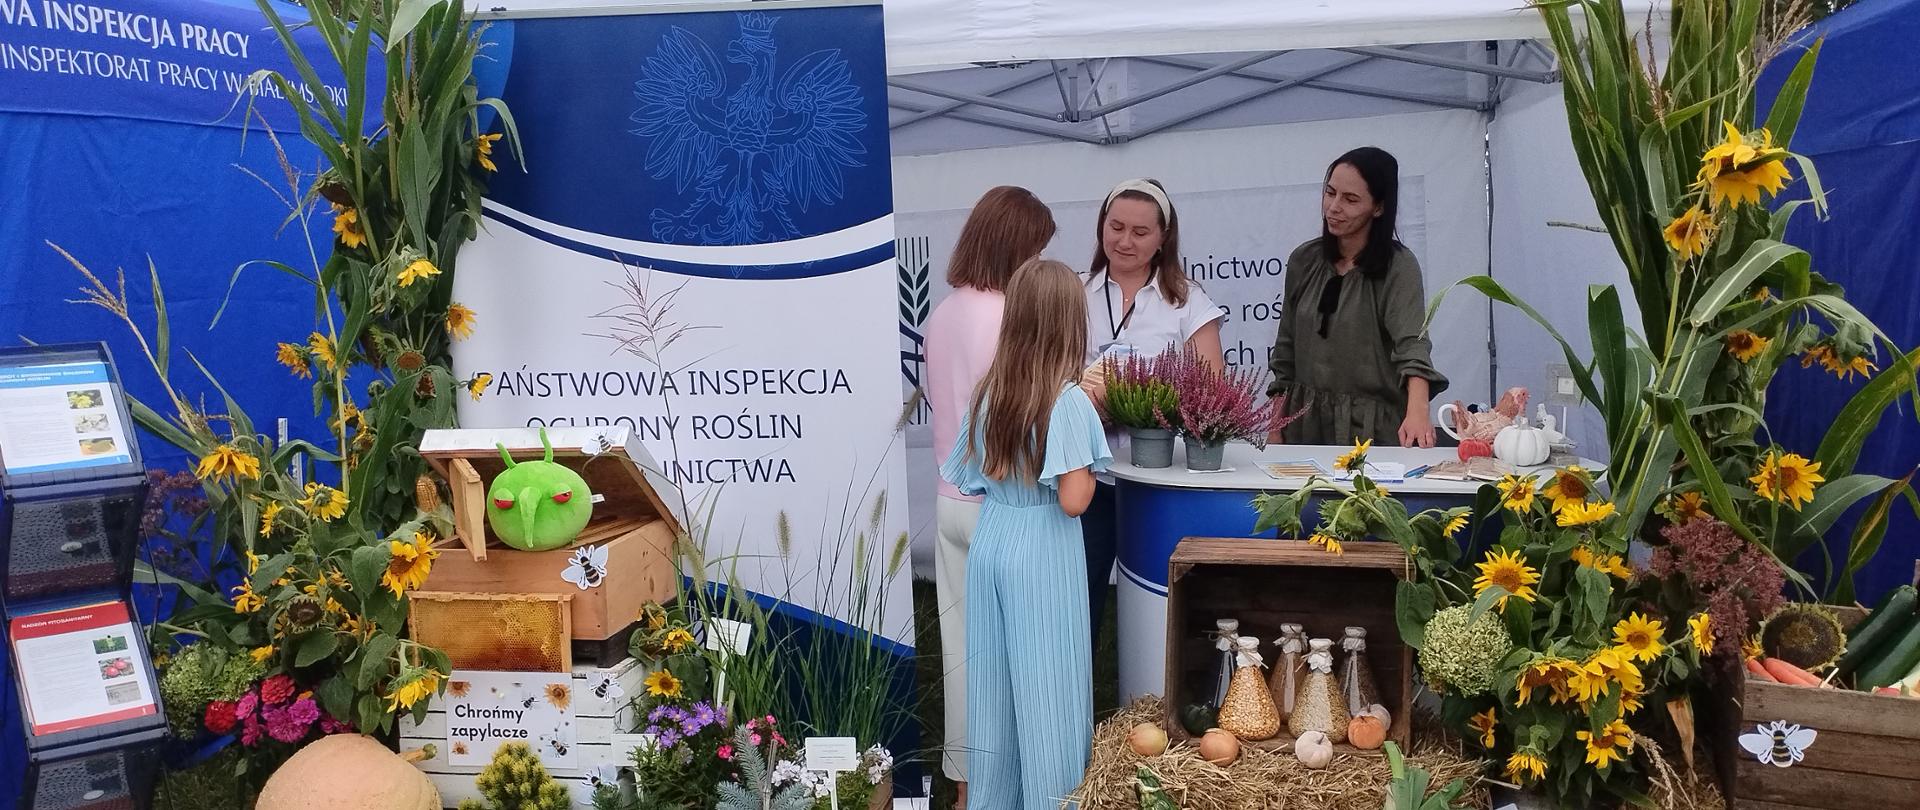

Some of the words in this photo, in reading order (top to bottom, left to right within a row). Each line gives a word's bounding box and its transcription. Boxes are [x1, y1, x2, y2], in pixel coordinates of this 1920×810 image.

[43, 0, 177, 49] INSPEKCJA
[181, 22, 250, 59] PRACY
[0, 43, 151, 83] INSPEKTORAT
[158, 61, 219, 91] PRACY
[223, 70, 242, 94] W
[688, 368, 853, 396] INSPEKCJA
[692, 408, 802, 440] ROŚLIN
[454, 703, 524, 725] Chrońmy
[451, 722, 529, 742] zapylacze
